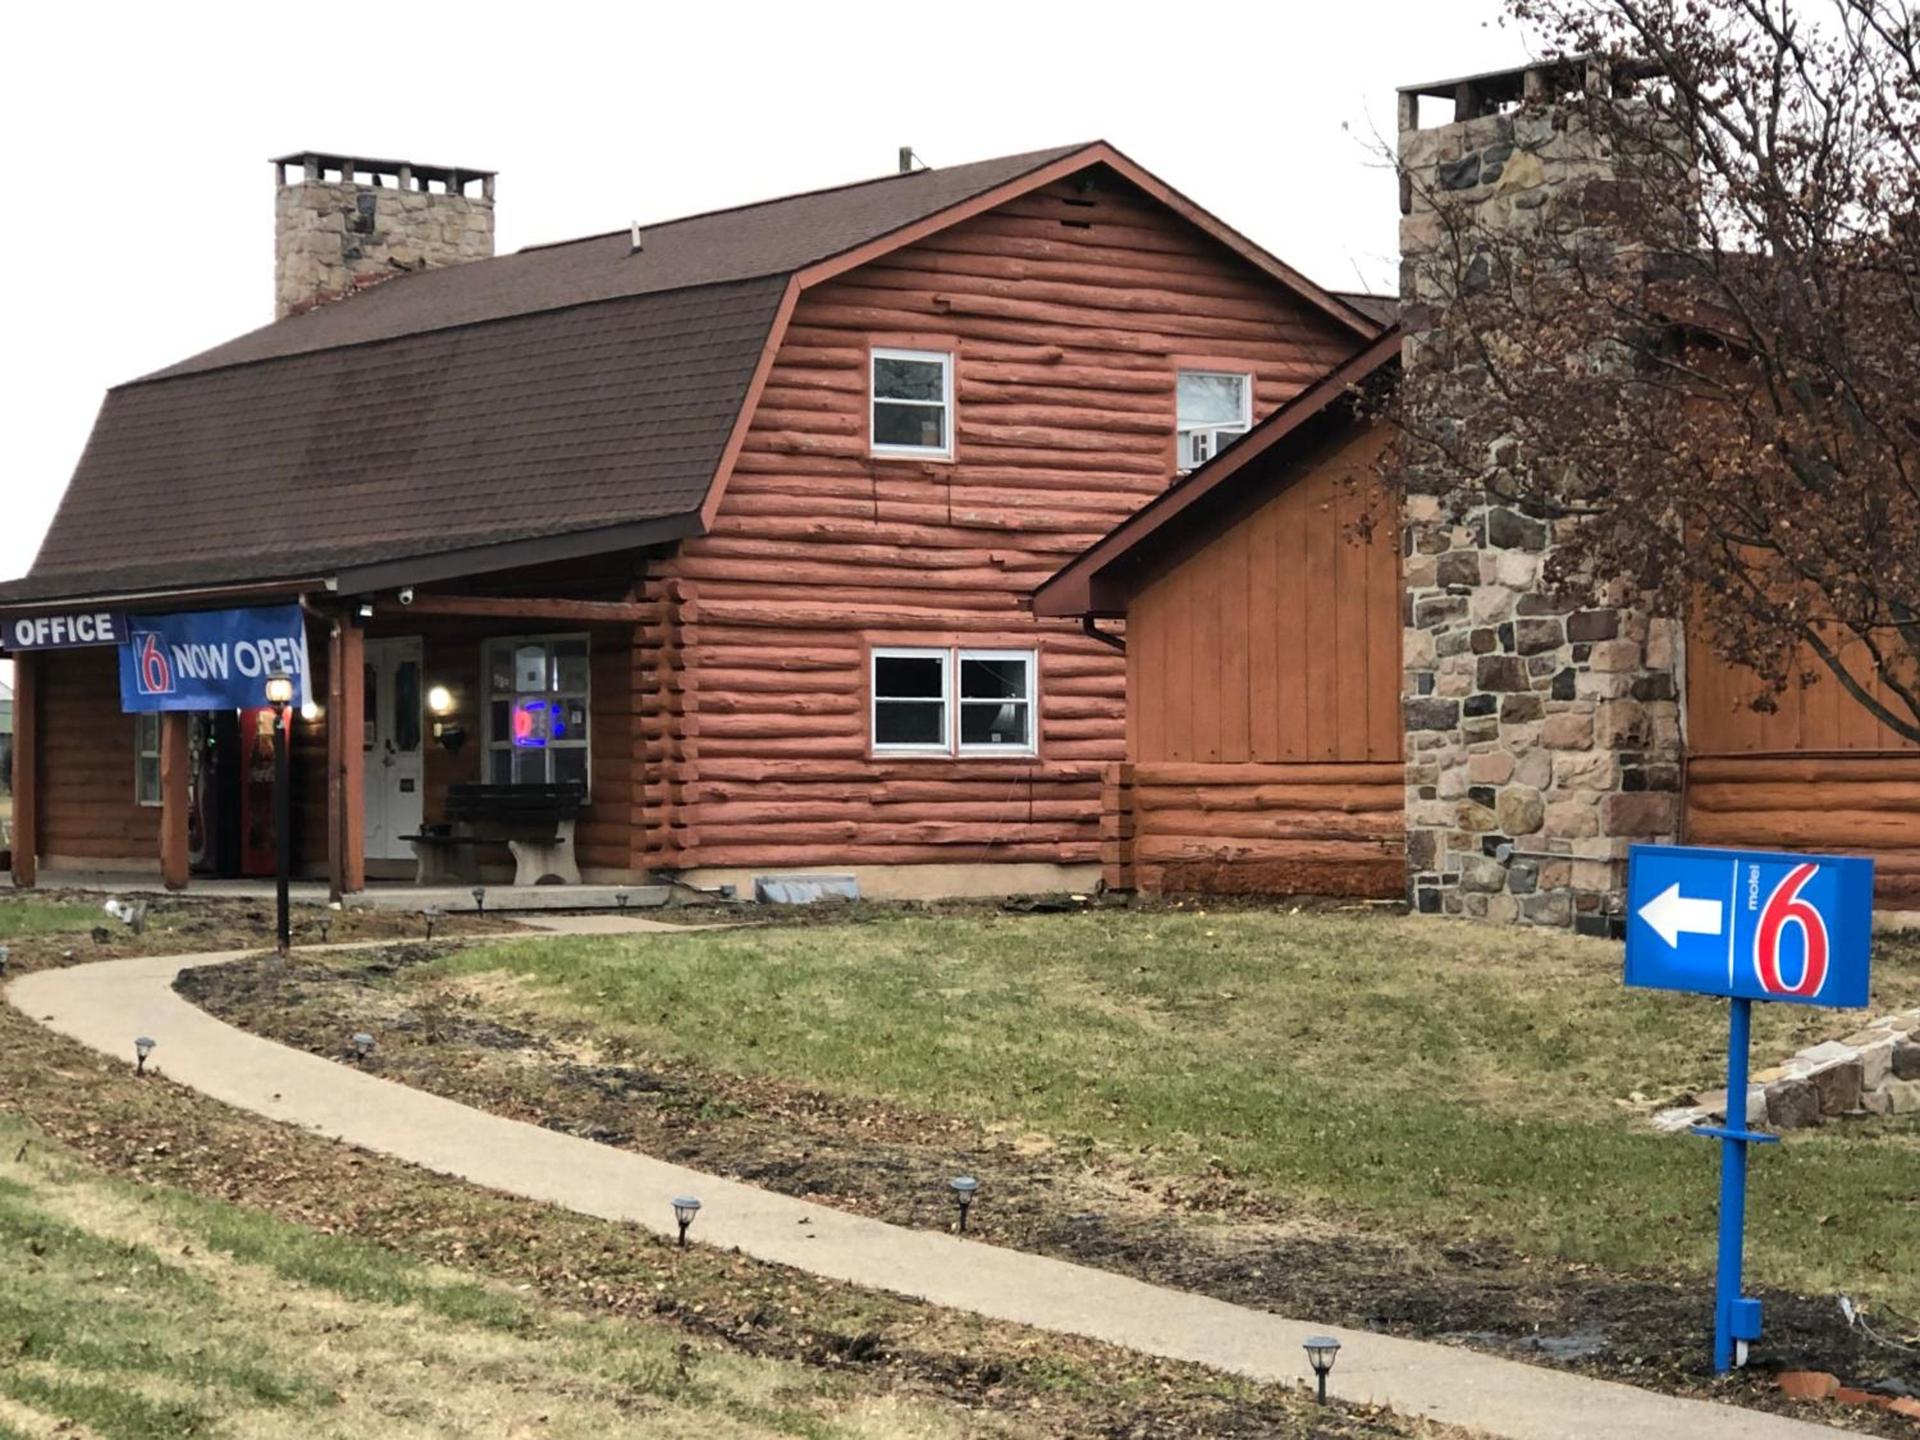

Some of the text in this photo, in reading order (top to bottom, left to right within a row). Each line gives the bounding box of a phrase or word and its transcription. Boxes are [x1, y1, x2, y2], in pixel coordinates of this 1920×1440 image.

[15, 613, 115, 646] OFFICE
[142, 632, 169, 692] 6
[171, 643, 228, 679] NOW
[1749, 865, 1760, 911] motel
[1753, 863, 1830, 998] 6
